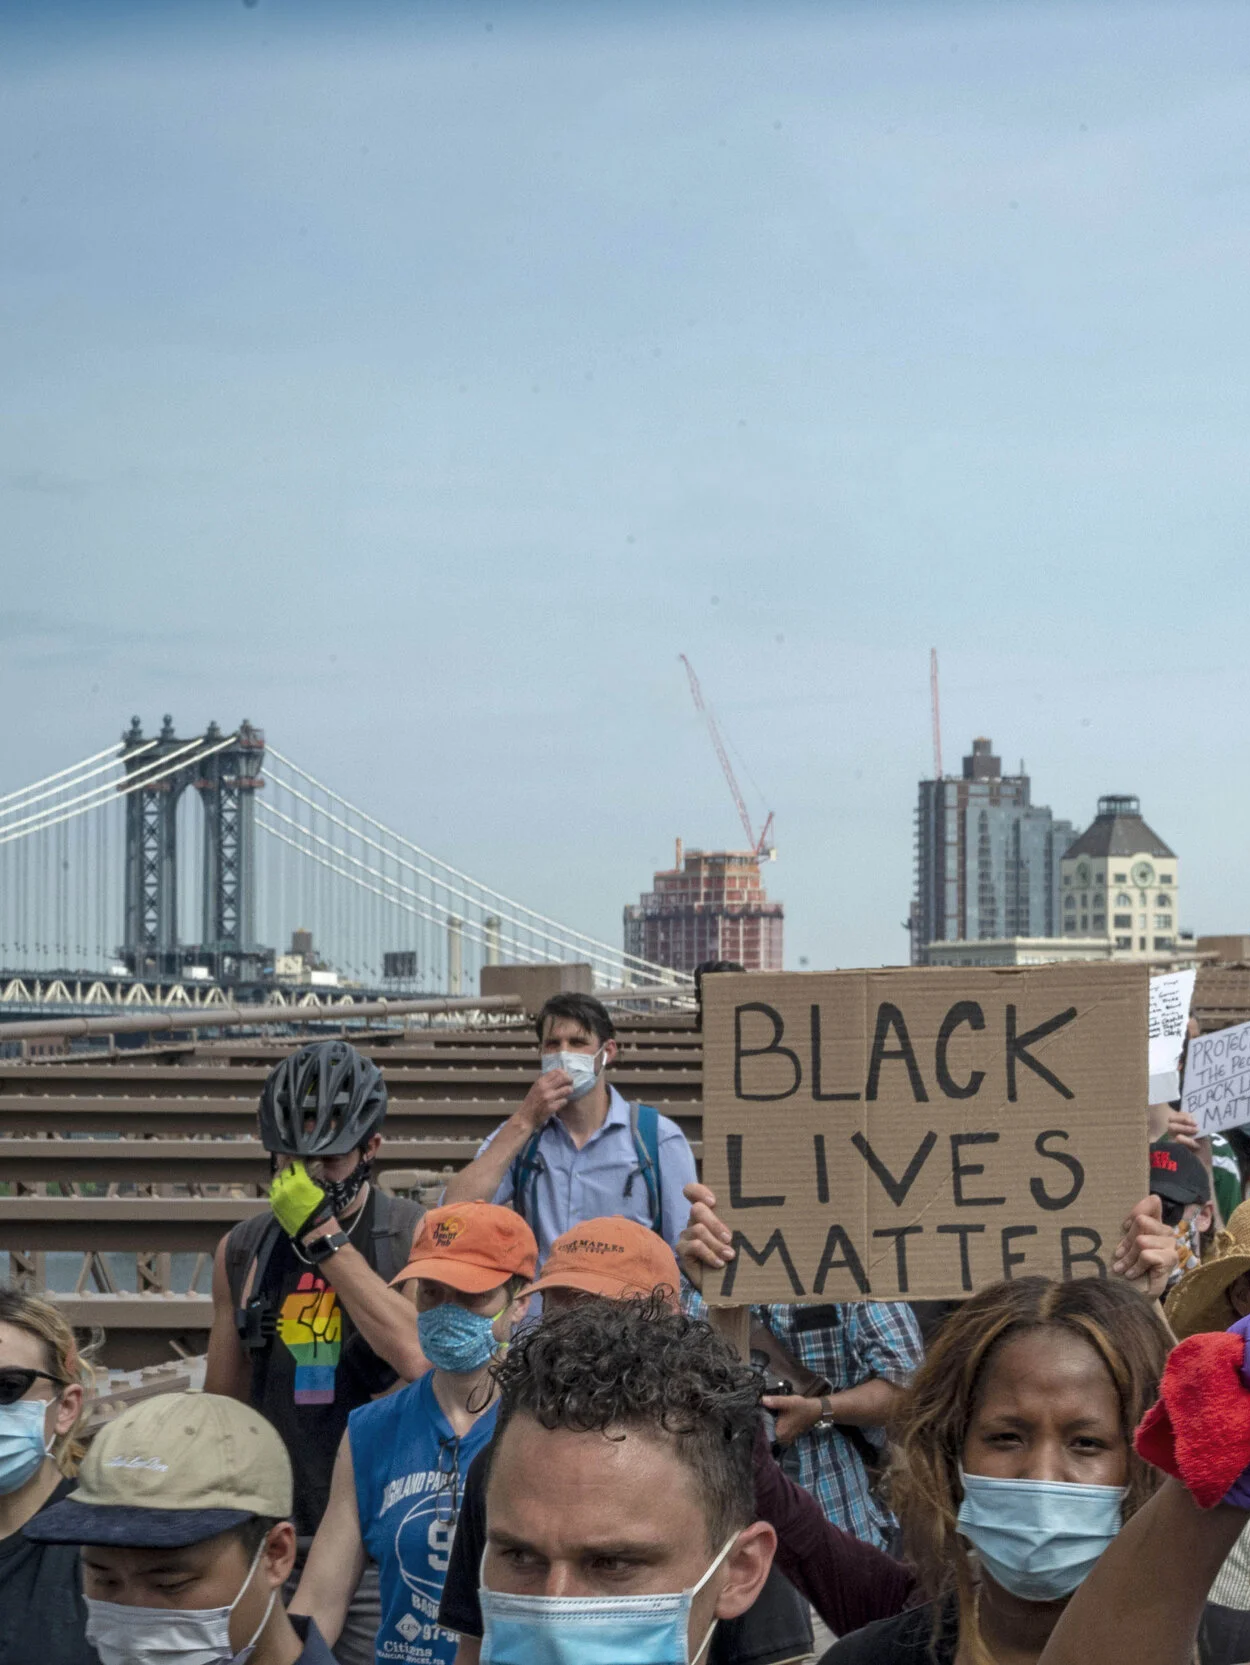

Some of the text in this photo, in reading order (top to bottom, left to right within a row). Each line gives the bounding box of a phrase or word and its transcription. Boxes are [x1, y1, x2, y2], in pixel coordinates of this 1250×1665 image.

[734, 1000, 1078, 1102] BLACK
[1196, 1064, 1226, 1086] THE
[1187, 1081, 1235, 1114] BLACK
[726, 1130, 1085, 1211] LIVES
[720, 1224, 1107, 1298] MATTER
[383, 1640, 433, 1658] Citizns
